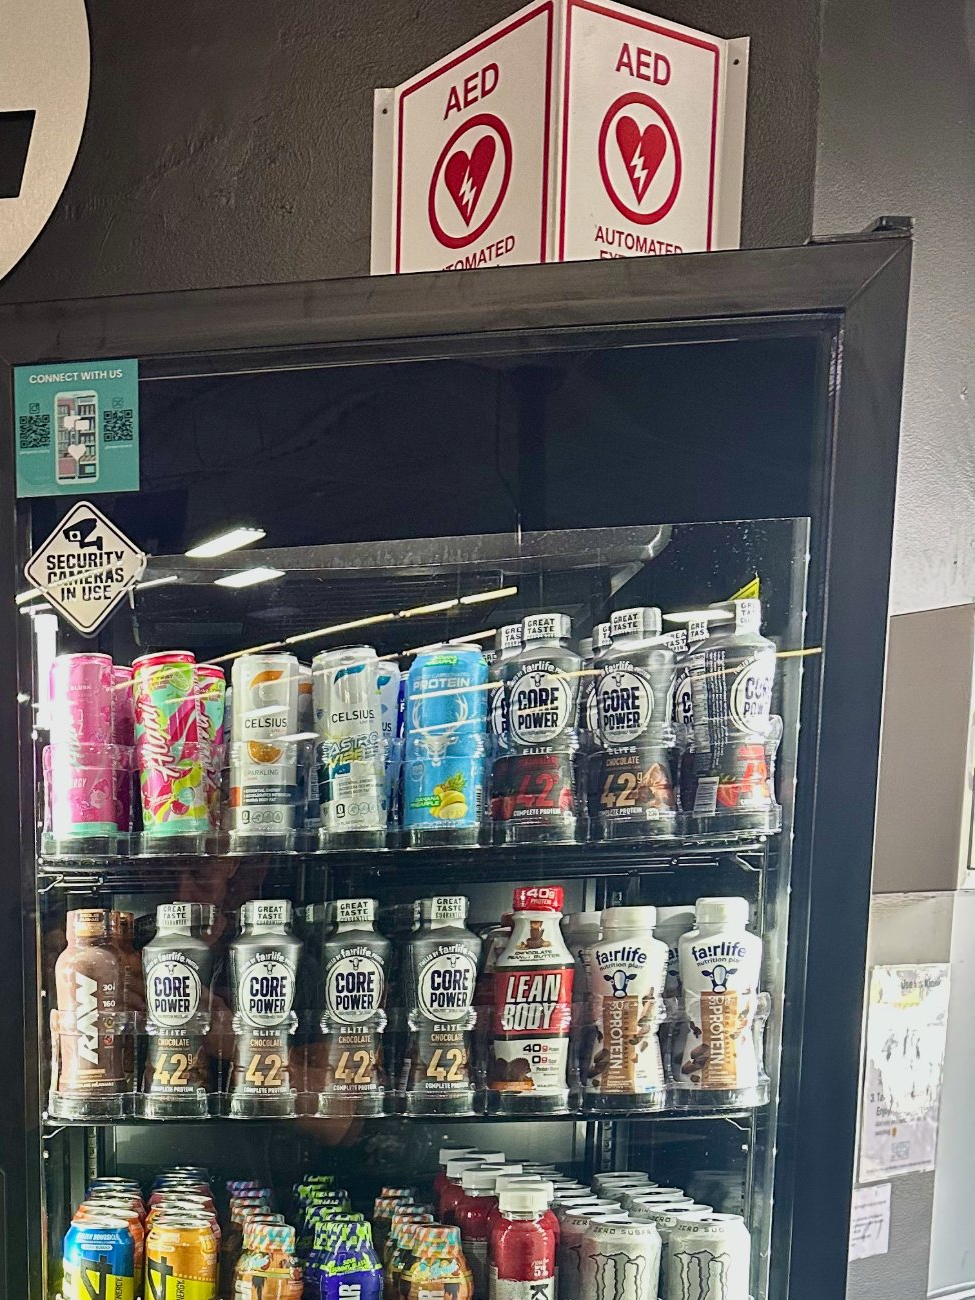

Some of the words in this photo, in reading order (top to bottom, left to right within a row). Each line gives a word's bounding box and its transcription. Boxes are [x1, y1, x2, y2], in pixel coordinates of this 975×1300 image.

[615, 43, 671, 85] AED
[444, 63, 499, 120] AED
[595, 226, 683, 255] AUTOMATED
[29, 372, 78, 384] CONNECT
[81, 371, 107, 381] WITH
[109, 370, 122, 379] US
[47, 551, 124, 570] SECURITY
[48, 567, 124, 586] CAMERAS
[61, 587, 76, 602] IN
[82, 585, 111, 601] USE
[527, 618, 555, 627] GREAT
[613, 613, 638, 623] GREAT
[527, 626, 555, 635] TASTE
[614, 621, 638, 630] TASTE
[413, 678, 470, 690] PROTEIN
[518, 688, 559, 712] CORE
[603, 687, 640, 710] CORE
[245, 717, 288, 729] CELSIUS
[332, 710, 375, 723] CELSIUS
[518, 714, 558, 730] POWER
[603, 713, 641, 729] POWER
[329, 733, 379, 754] ASTRO
[607, 756, 640, 766] CHOCOLATE
[163, 905, 187, 913] GREAT
[257, 905, 283, 914] GREAT
[340, 901, 368, 910] GREAT
[340, 909, 368, 917] TASTE
[600, 962, 626, 971] nutrition
[697, 957, 727, 967] nutrition
[154, 976, 191, 997] CORE
[250, 976, 287, 998] CORE
[335, 971, 375, 993] CORE
[431, 969, 470, 991] CORE
[506, 974, 561, 1003] LEAN
[155, 999, 190, 1013] POWER
[249, 999, 285, 1014] POWER
[336, 994, 374, 1011] POWER
[430, 992, 468, 1008] POWER
[503, 1003, 556, 1031] BODY
[158, 1038, 190, 1047] CHOCOLATE
[250, 1038, 283, 1047] CHOCOLATE
[338, 1034, 371, 1044] CHOCOLATE
[431, 1033, 464, 1042] CHOCOLATE
